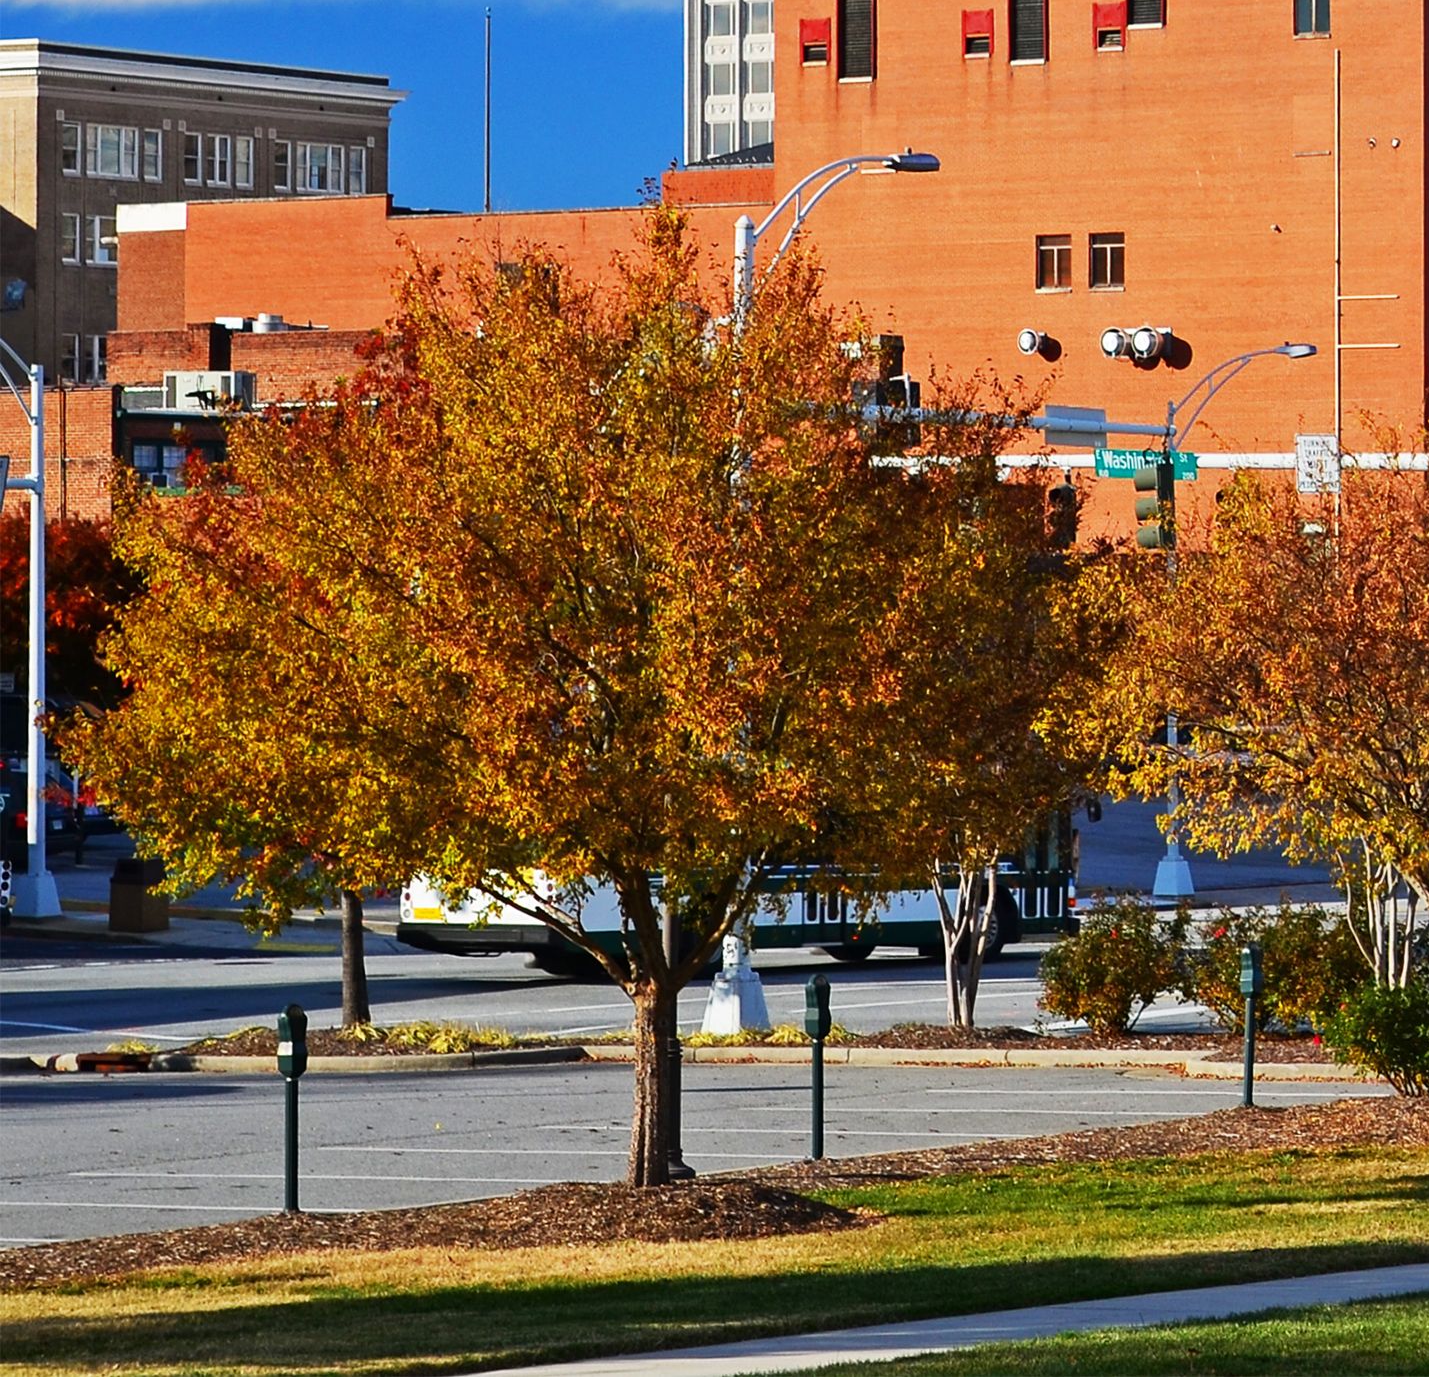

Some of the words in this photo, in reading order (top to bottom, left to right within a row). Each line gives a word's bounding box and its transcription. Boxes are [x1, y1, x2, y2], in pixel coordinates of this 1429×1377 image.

[1096, 450, 1101, 460] E
[1102, 450, 1174, 470] Washin
[1179, 453, 1188, 463] St
